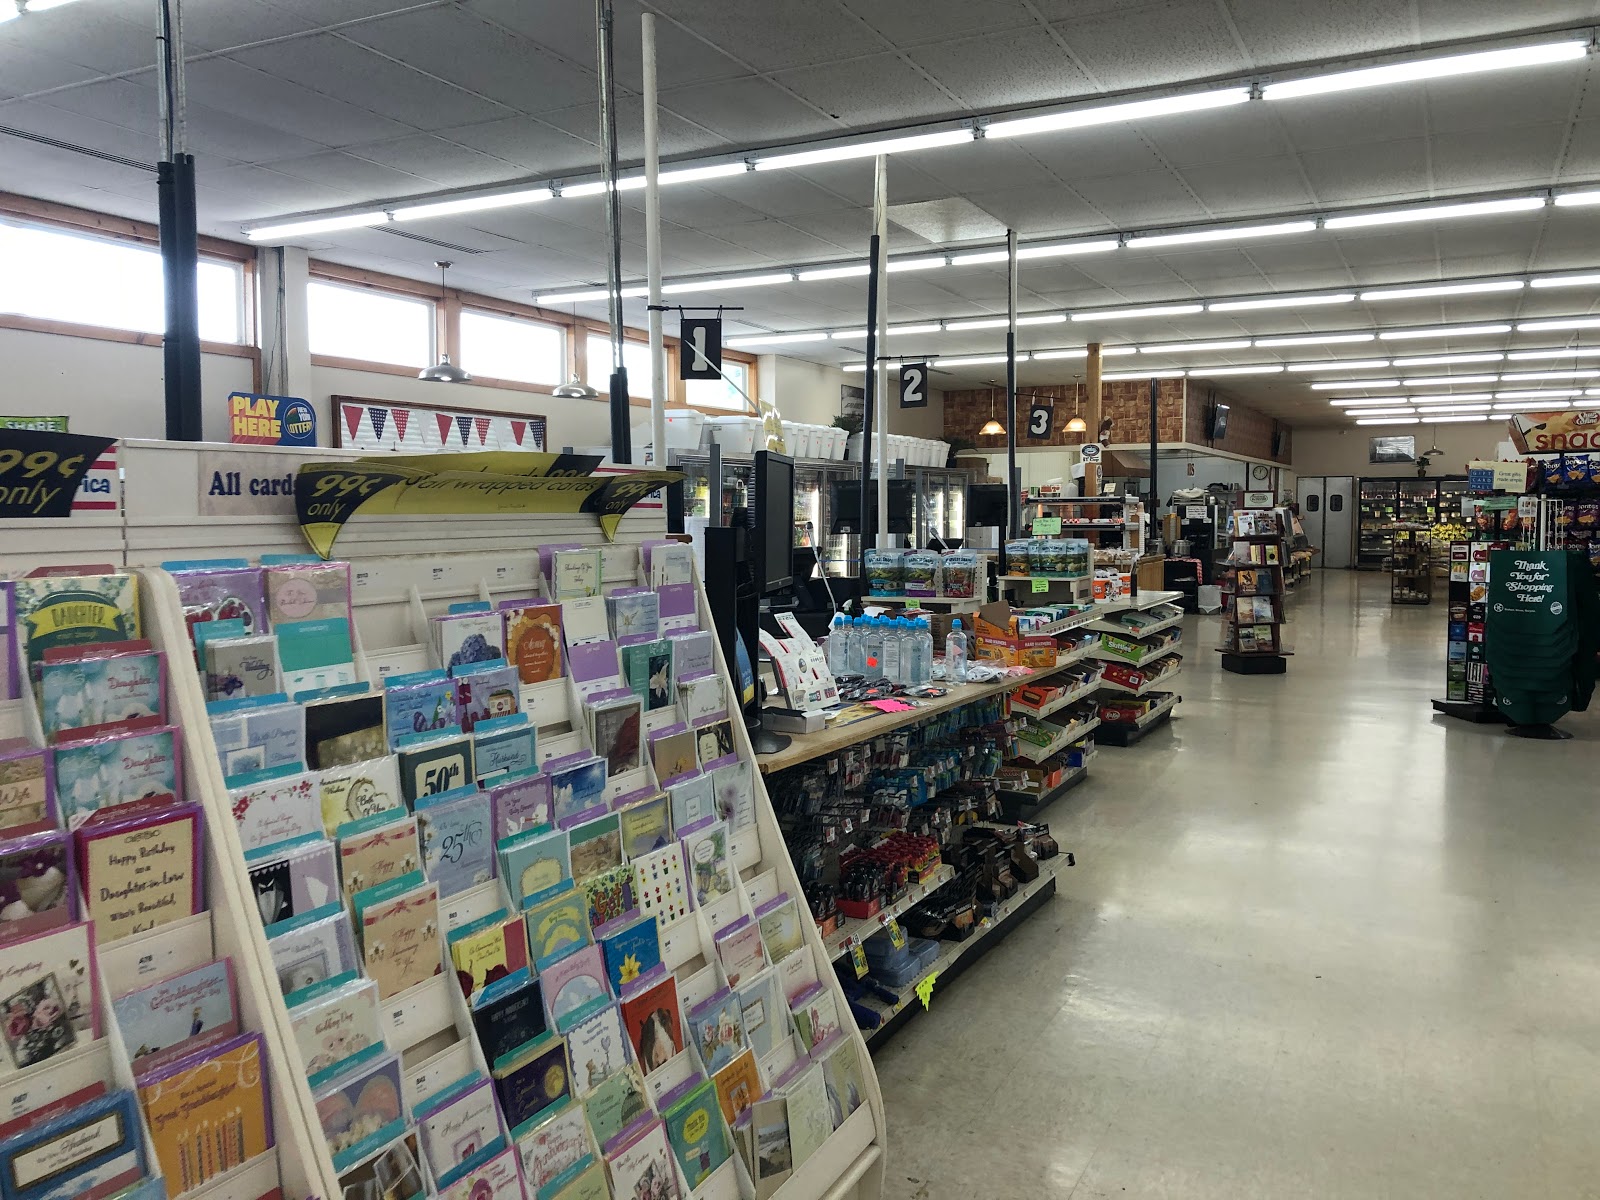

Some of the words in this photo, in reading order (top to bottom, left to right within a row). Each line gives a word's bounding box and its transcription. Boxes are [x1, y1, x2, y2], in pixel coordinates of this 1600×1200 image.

[692, 327, 708, 371] 1
[903, 369, 922, 402] 2
[233, 396, 279, 418] PLAY
[234, 416, 281, 438] HERE
[1031, 410, 1049, 435] 3
[209, 471, 241, 496] All
[310, 475, 382, 498] 99¢
[454, 480, 544, 496] wrapped
[547, 480, 595, 492] cards
[611, 482, 657, 498] 99¢
[0, 479, 60, 514] nly
[606, 500, 629, 512] only
[308, 499, 345, 521] only
[1514, 560, 1549, 571] Thank
[1505, 582, 1554, 593] Shopping
[1510, 572, 1532, 581] You
[1530, 572, 1549, 582] for
[1517, 593, 1545, 603] Here!
[1108, 642, 1131, 653] Skittles
[108, 671, 153, 692] Daughter
[122, 750, 166, 771] Daughter
[423, 763, 459, 798] 50th
[109, 854, 137, 866] Happy
[139, 842, 176, 858] Birthday
[595, 889, 621, 914] Get
